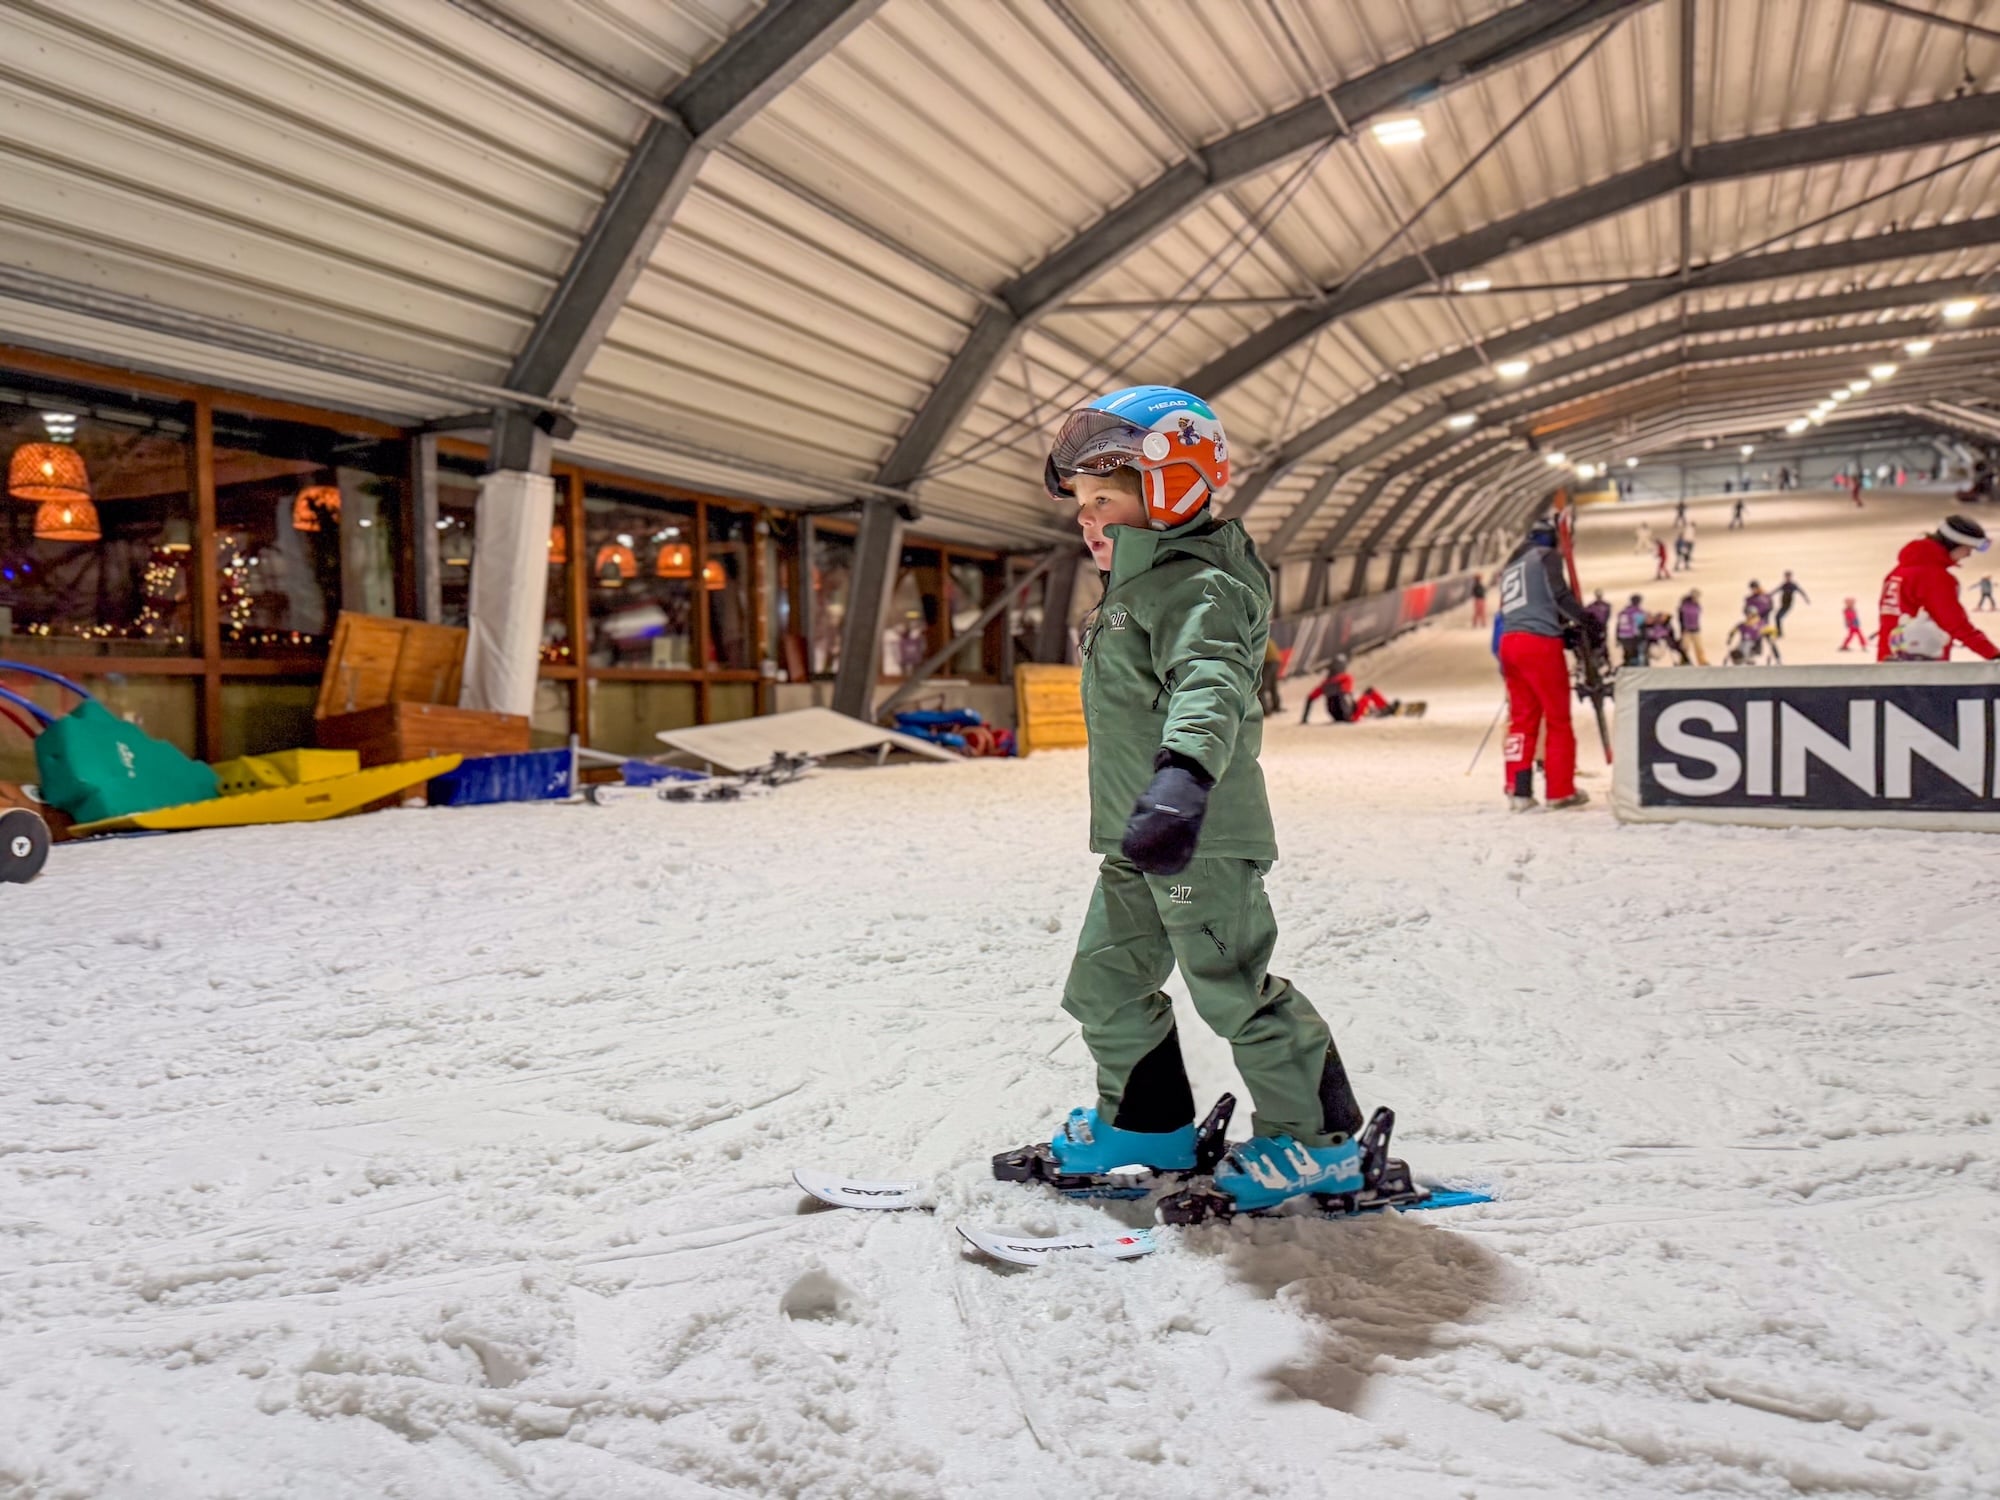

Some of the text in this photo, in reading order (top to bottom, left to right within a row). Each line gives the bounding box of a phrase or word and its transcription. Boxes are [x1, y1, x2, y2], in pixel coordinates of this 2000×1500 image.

[1147, 400, 1188, 412] HEAD
[1652, 698, 2000, 799] SINN
[1286, 1156, 1360, 1192] HEAD
